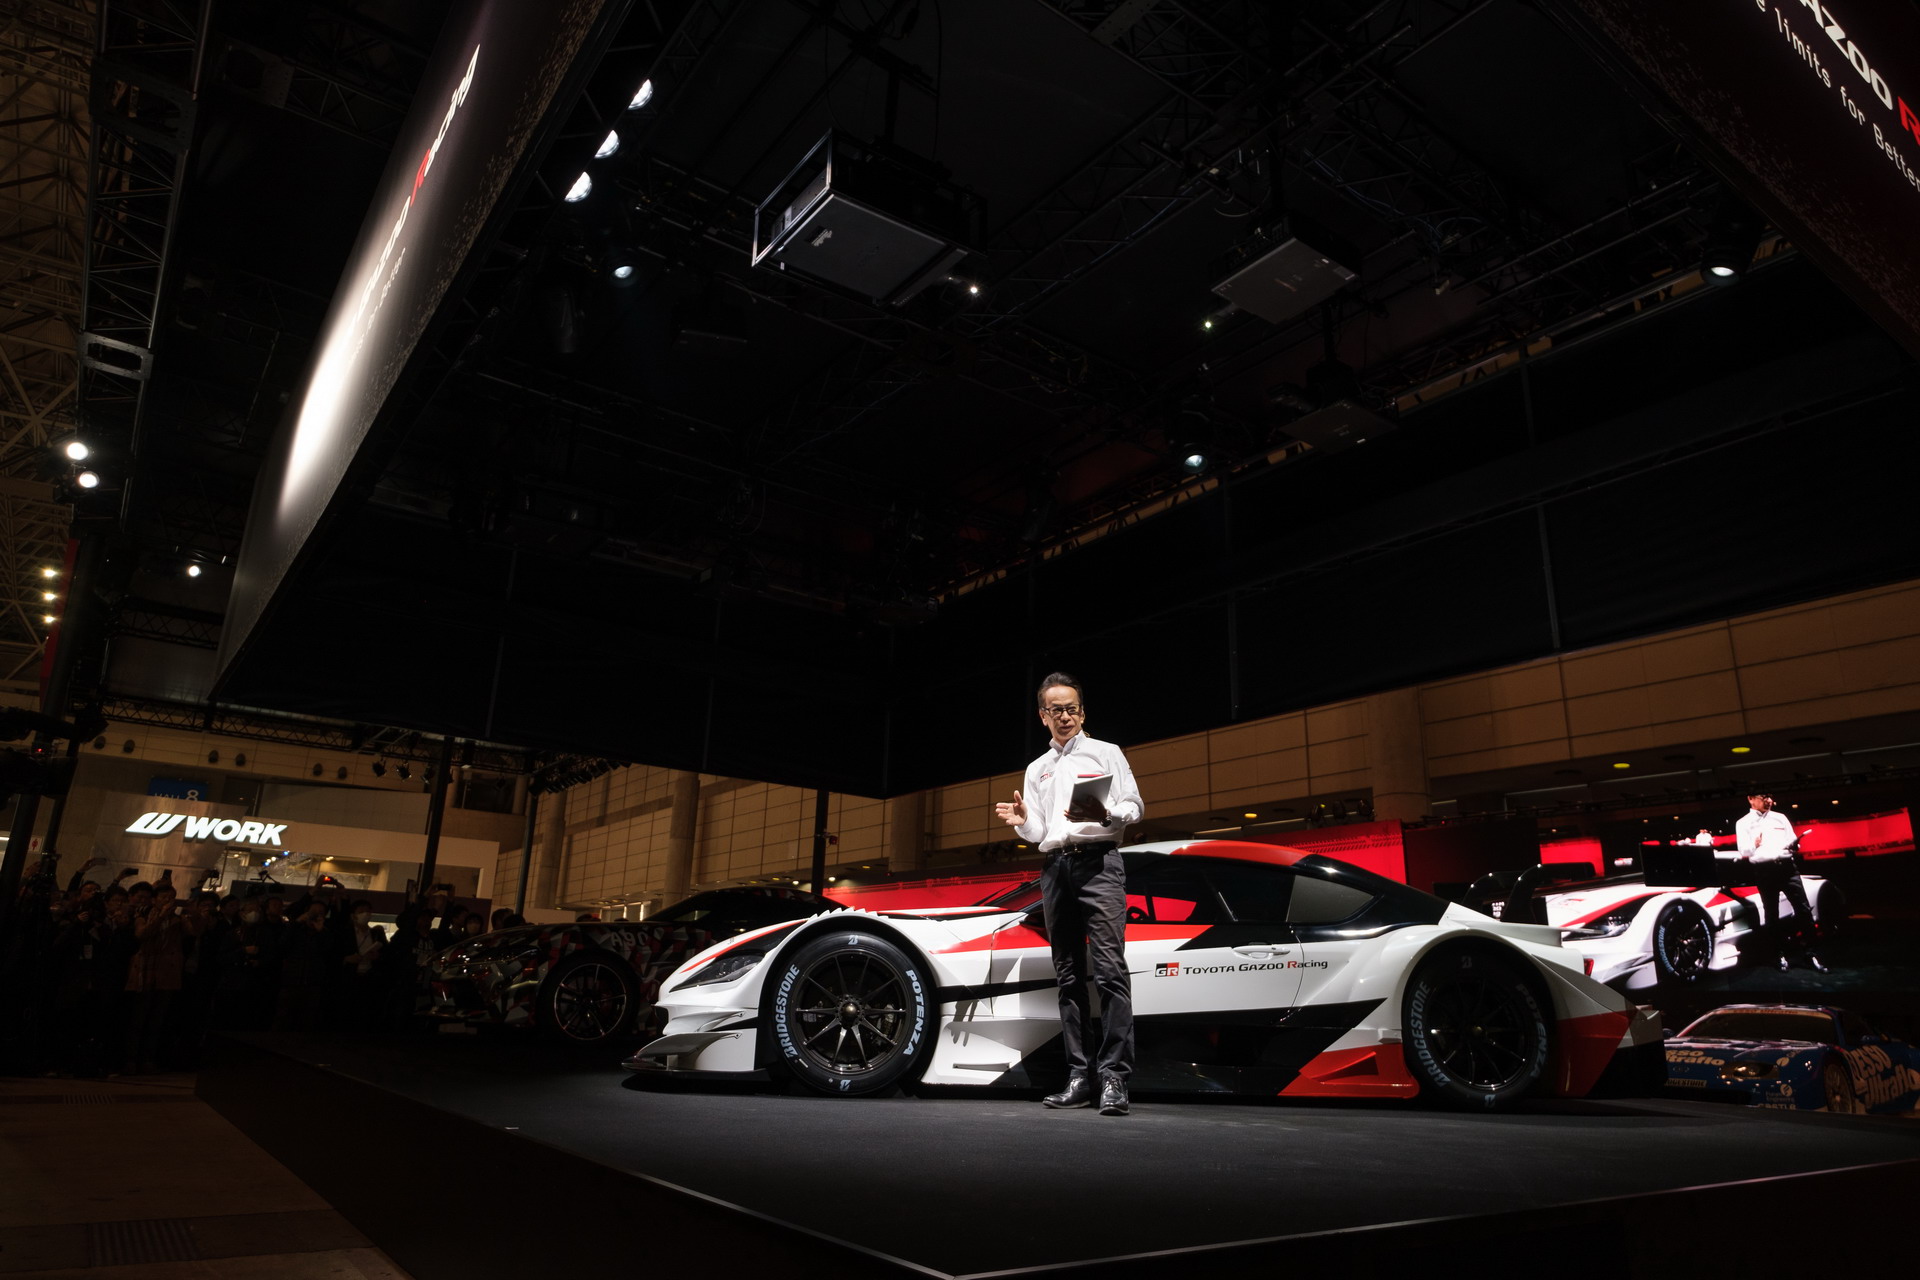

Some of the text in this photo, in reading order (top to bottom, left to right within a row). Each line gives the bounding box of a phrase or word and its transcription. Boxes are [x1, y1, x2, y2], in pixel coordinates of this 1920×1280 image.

[1774, 7, 1832, 89] limits
[1839, 85, 1866, 126] for
[184, 815, 288, 847] WORK
[775, 963, 801, 1059] BRIDGESTONE
[903, 969, 926, 1056] POTENZA
[1154, 960, 1328, 978] GR TOYOTA GAZOO Racing
[1410, 981, 1452, 1088] BRIDGESTONE
